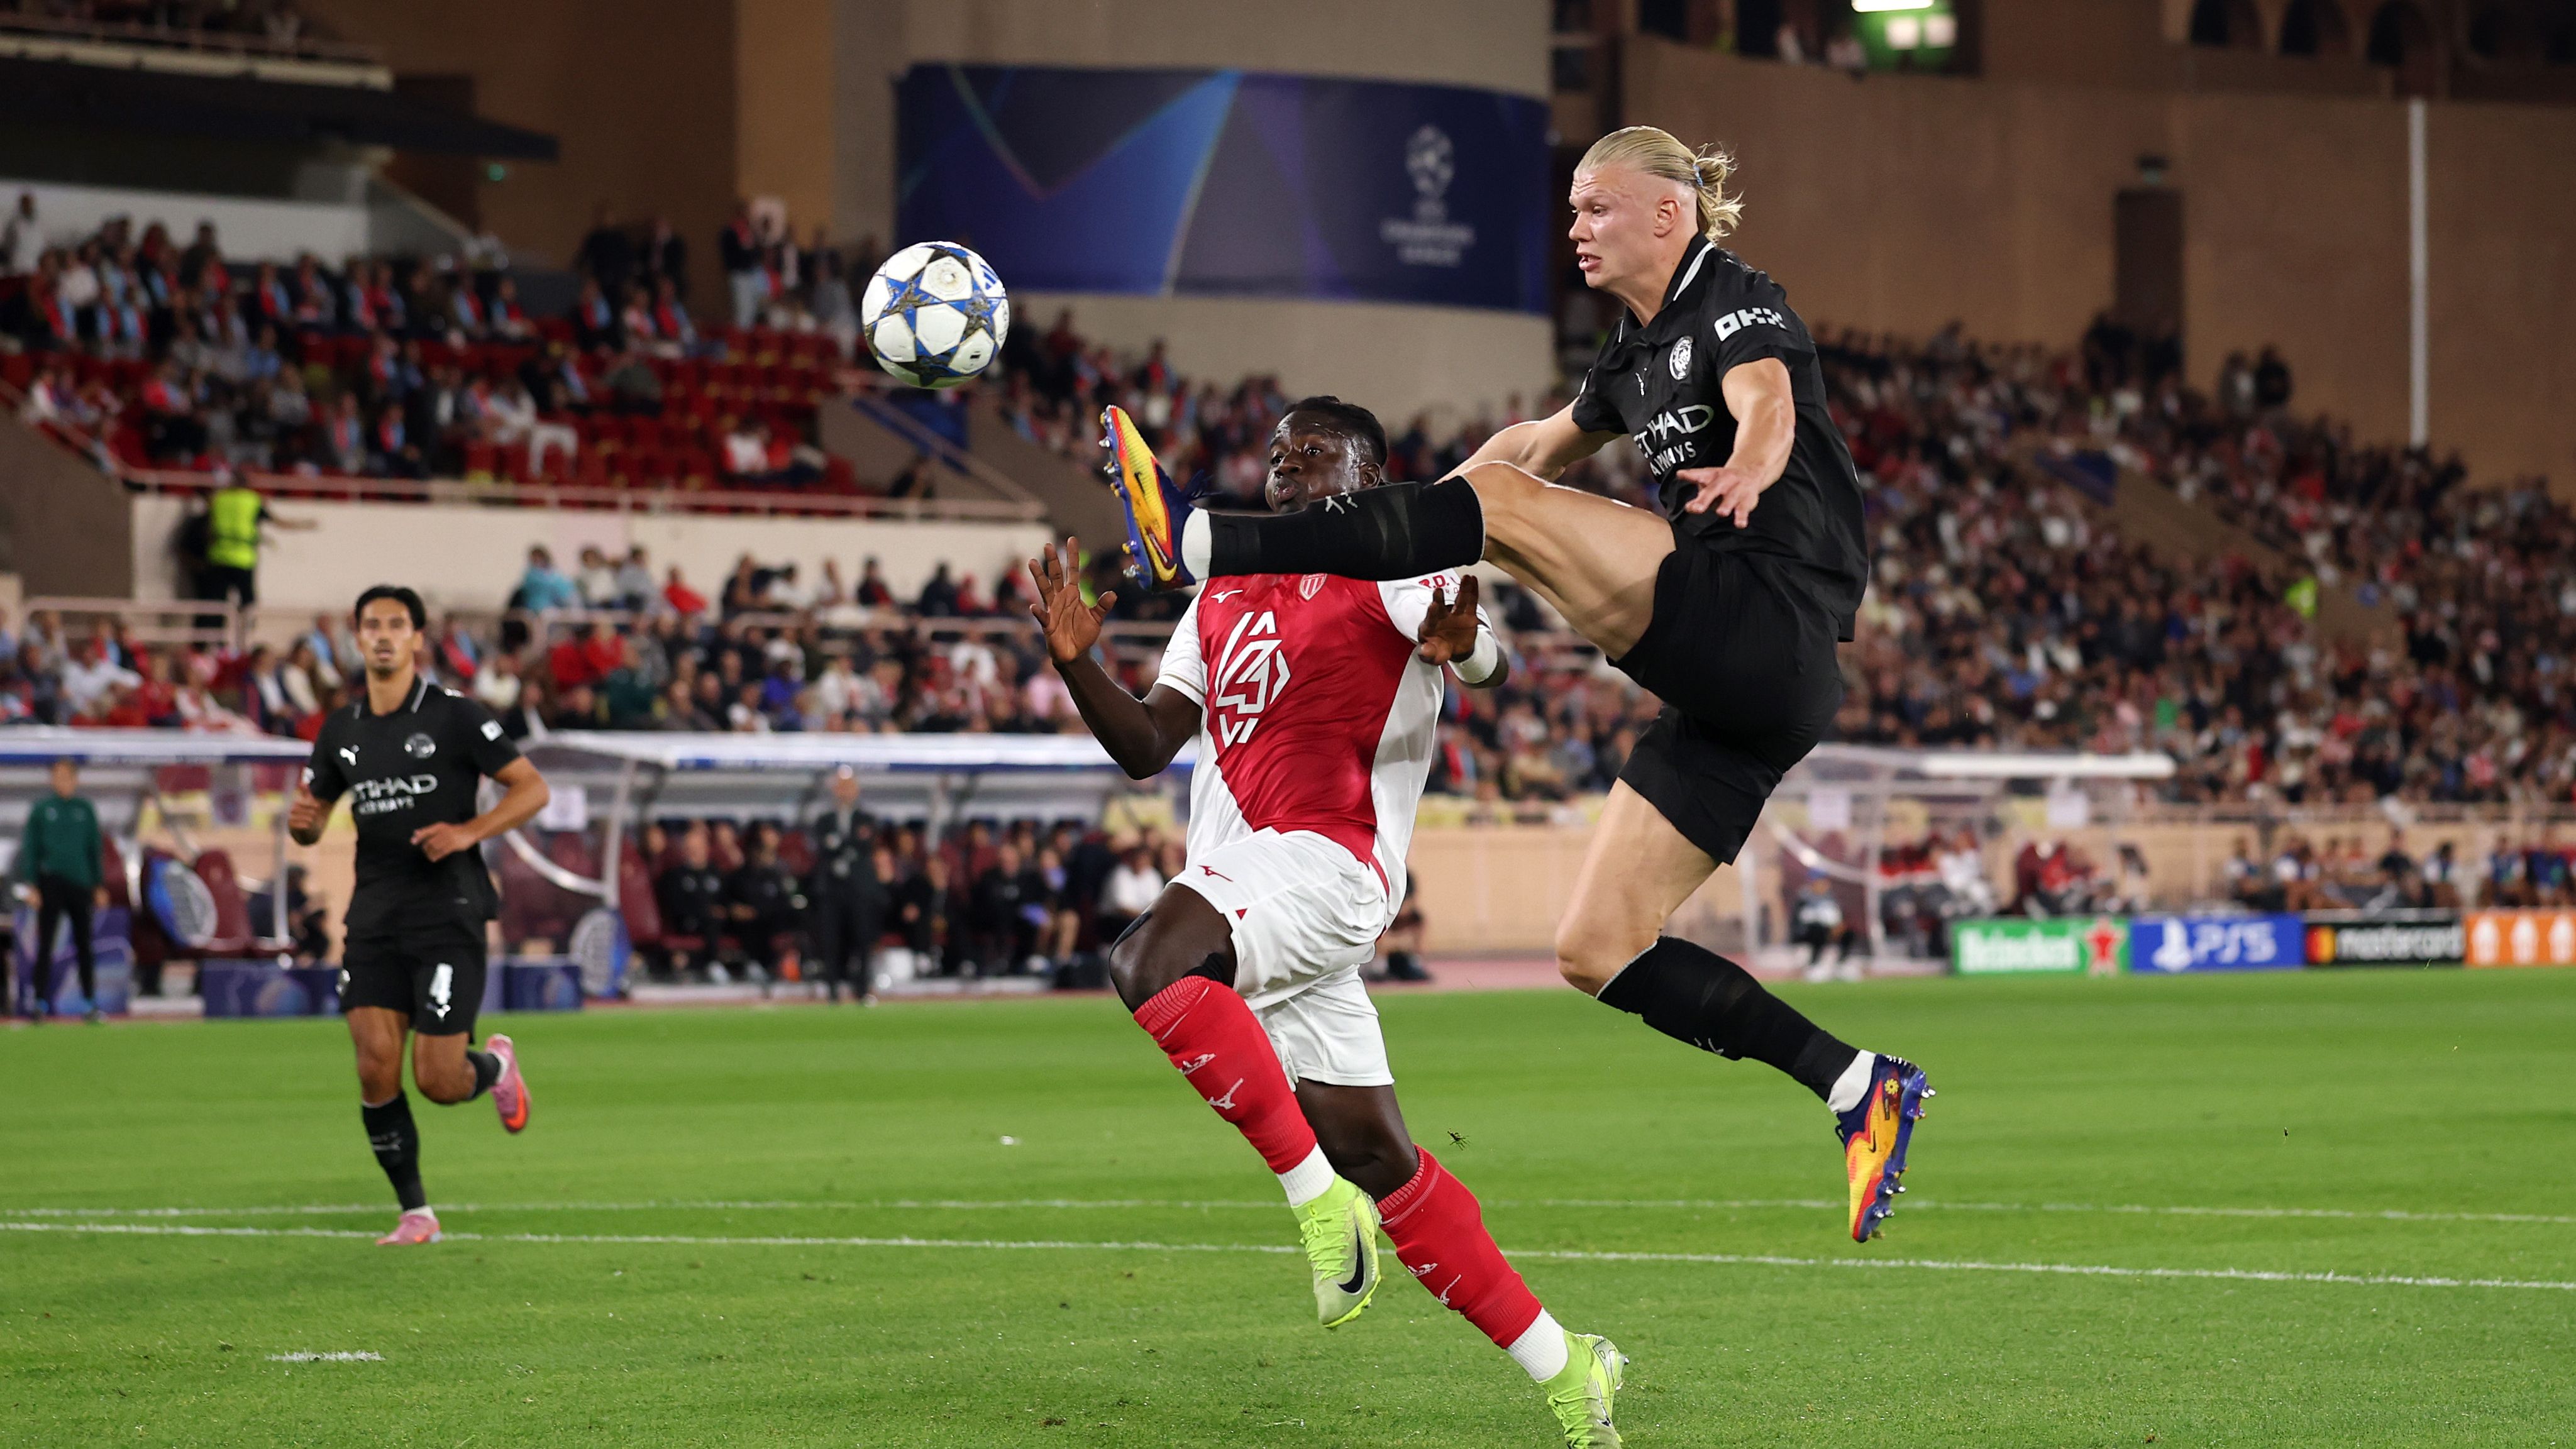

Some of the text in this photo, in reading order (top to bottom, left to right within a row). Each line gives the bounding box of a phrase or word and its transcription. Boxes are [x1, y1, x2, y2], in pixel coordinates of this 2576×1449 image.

[355, 774, 438, 800] TIHAD
[2192, 921, 2277, 964] PS5
[429, 962, 453, 1005] 4
